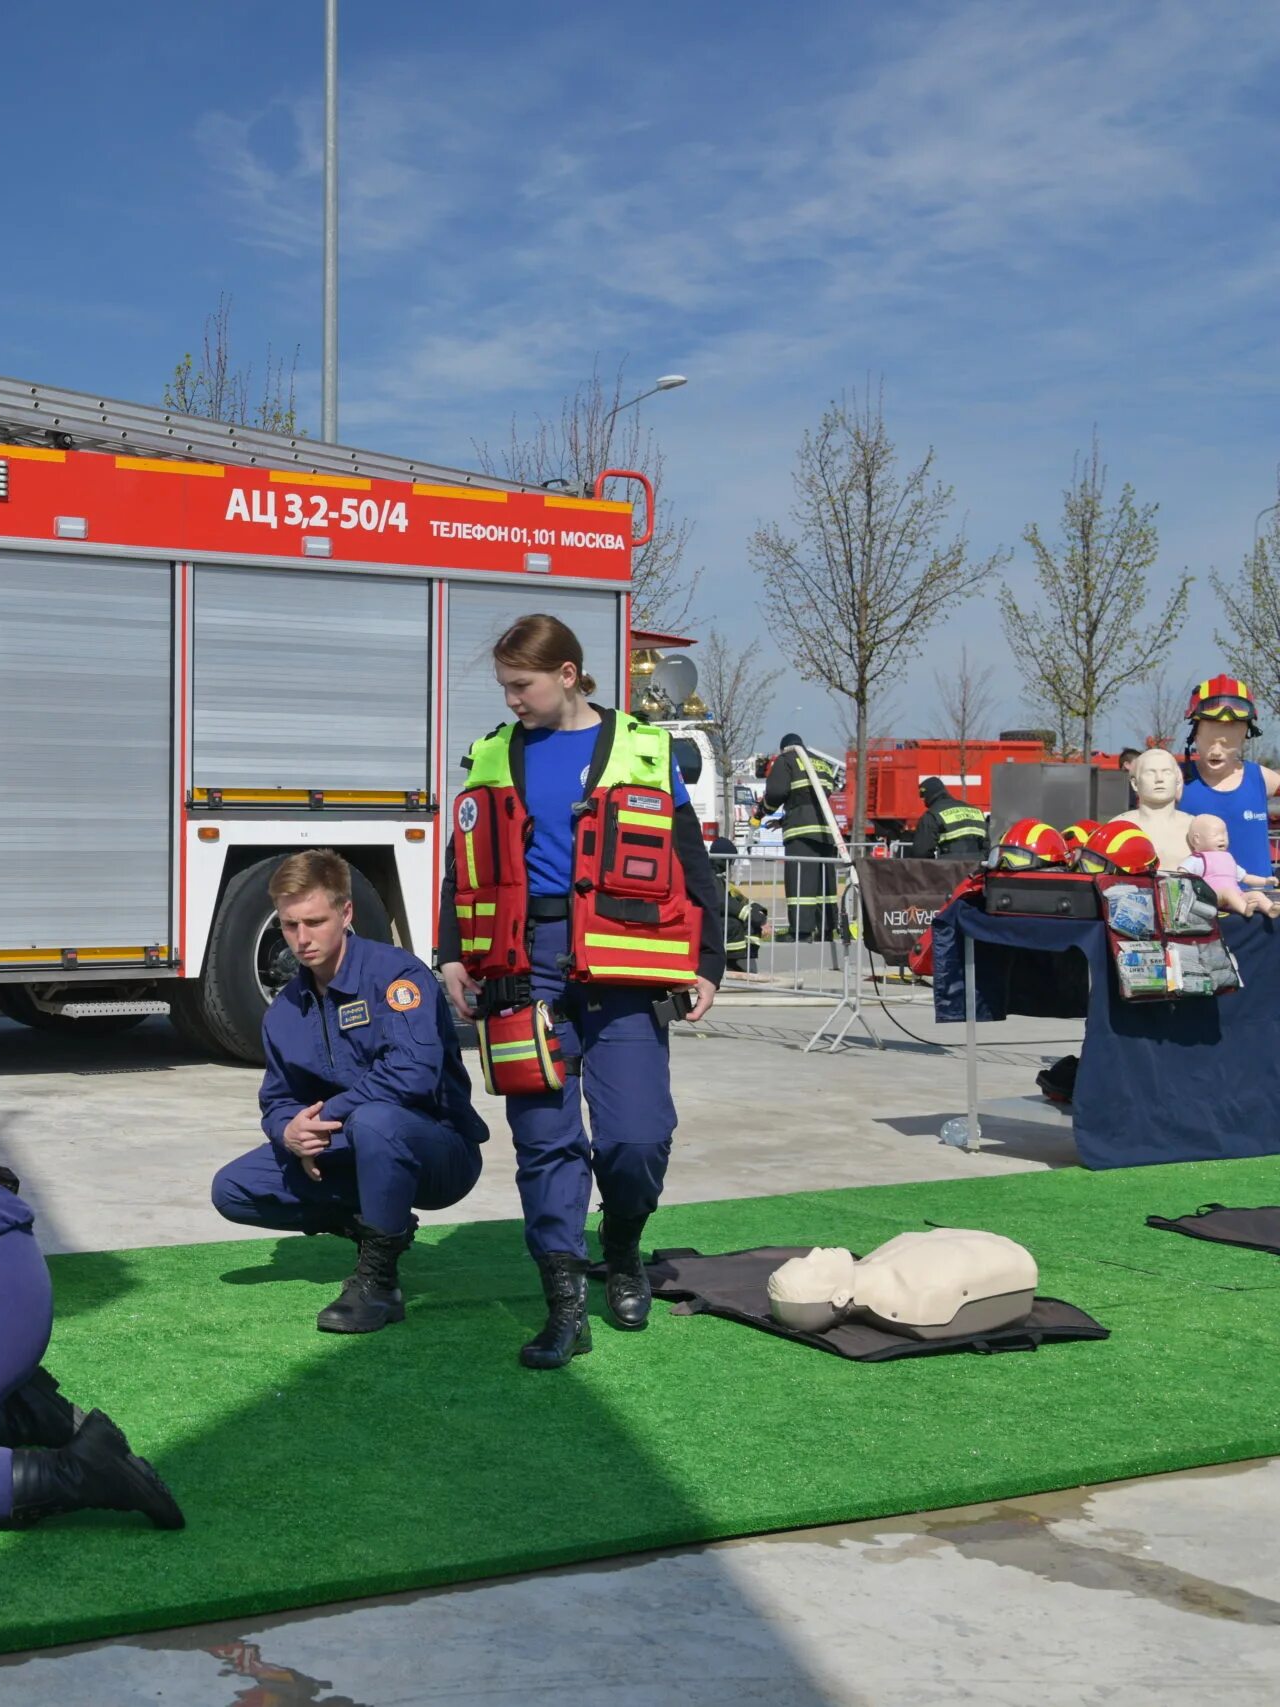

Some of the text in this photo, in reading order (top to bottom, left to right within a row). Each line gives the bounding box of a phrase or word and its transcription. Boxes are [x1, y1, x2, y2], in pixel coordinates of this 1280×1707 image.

[225, 487, 409, 533] АЦ 3,2-50/4
[429, 520, 508, 543] ТЕЛЕФОН
[560, 530, 625, 551] МОСКВА
